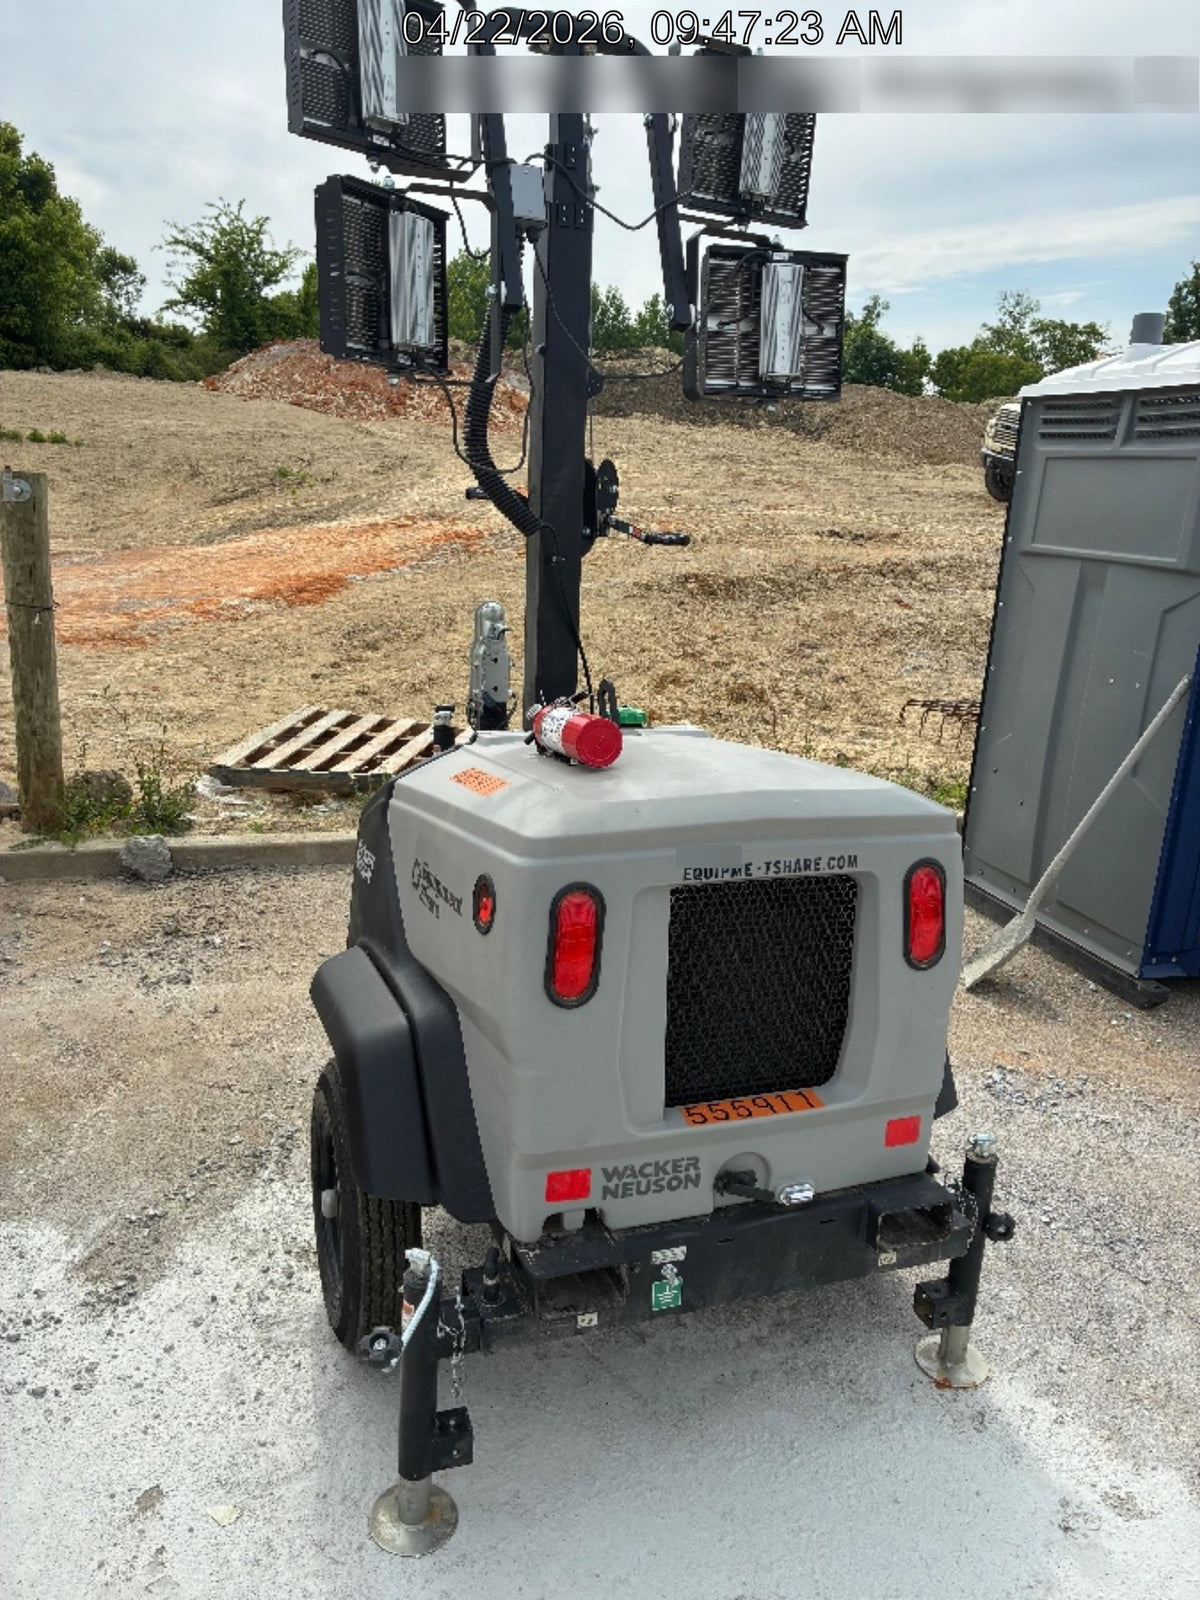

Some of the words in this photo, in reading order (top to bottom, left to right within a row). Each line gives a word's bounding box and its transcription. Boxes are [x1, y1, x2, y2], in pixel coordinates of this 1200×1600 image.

[683, 854, 859, 881] EQUIPMETSHARE.COM
[684, 1090, 816, 1125] 555911
[600, 1156, 701, 1183] WACKER
[601, 1172, 701, 1201] NEUSON
